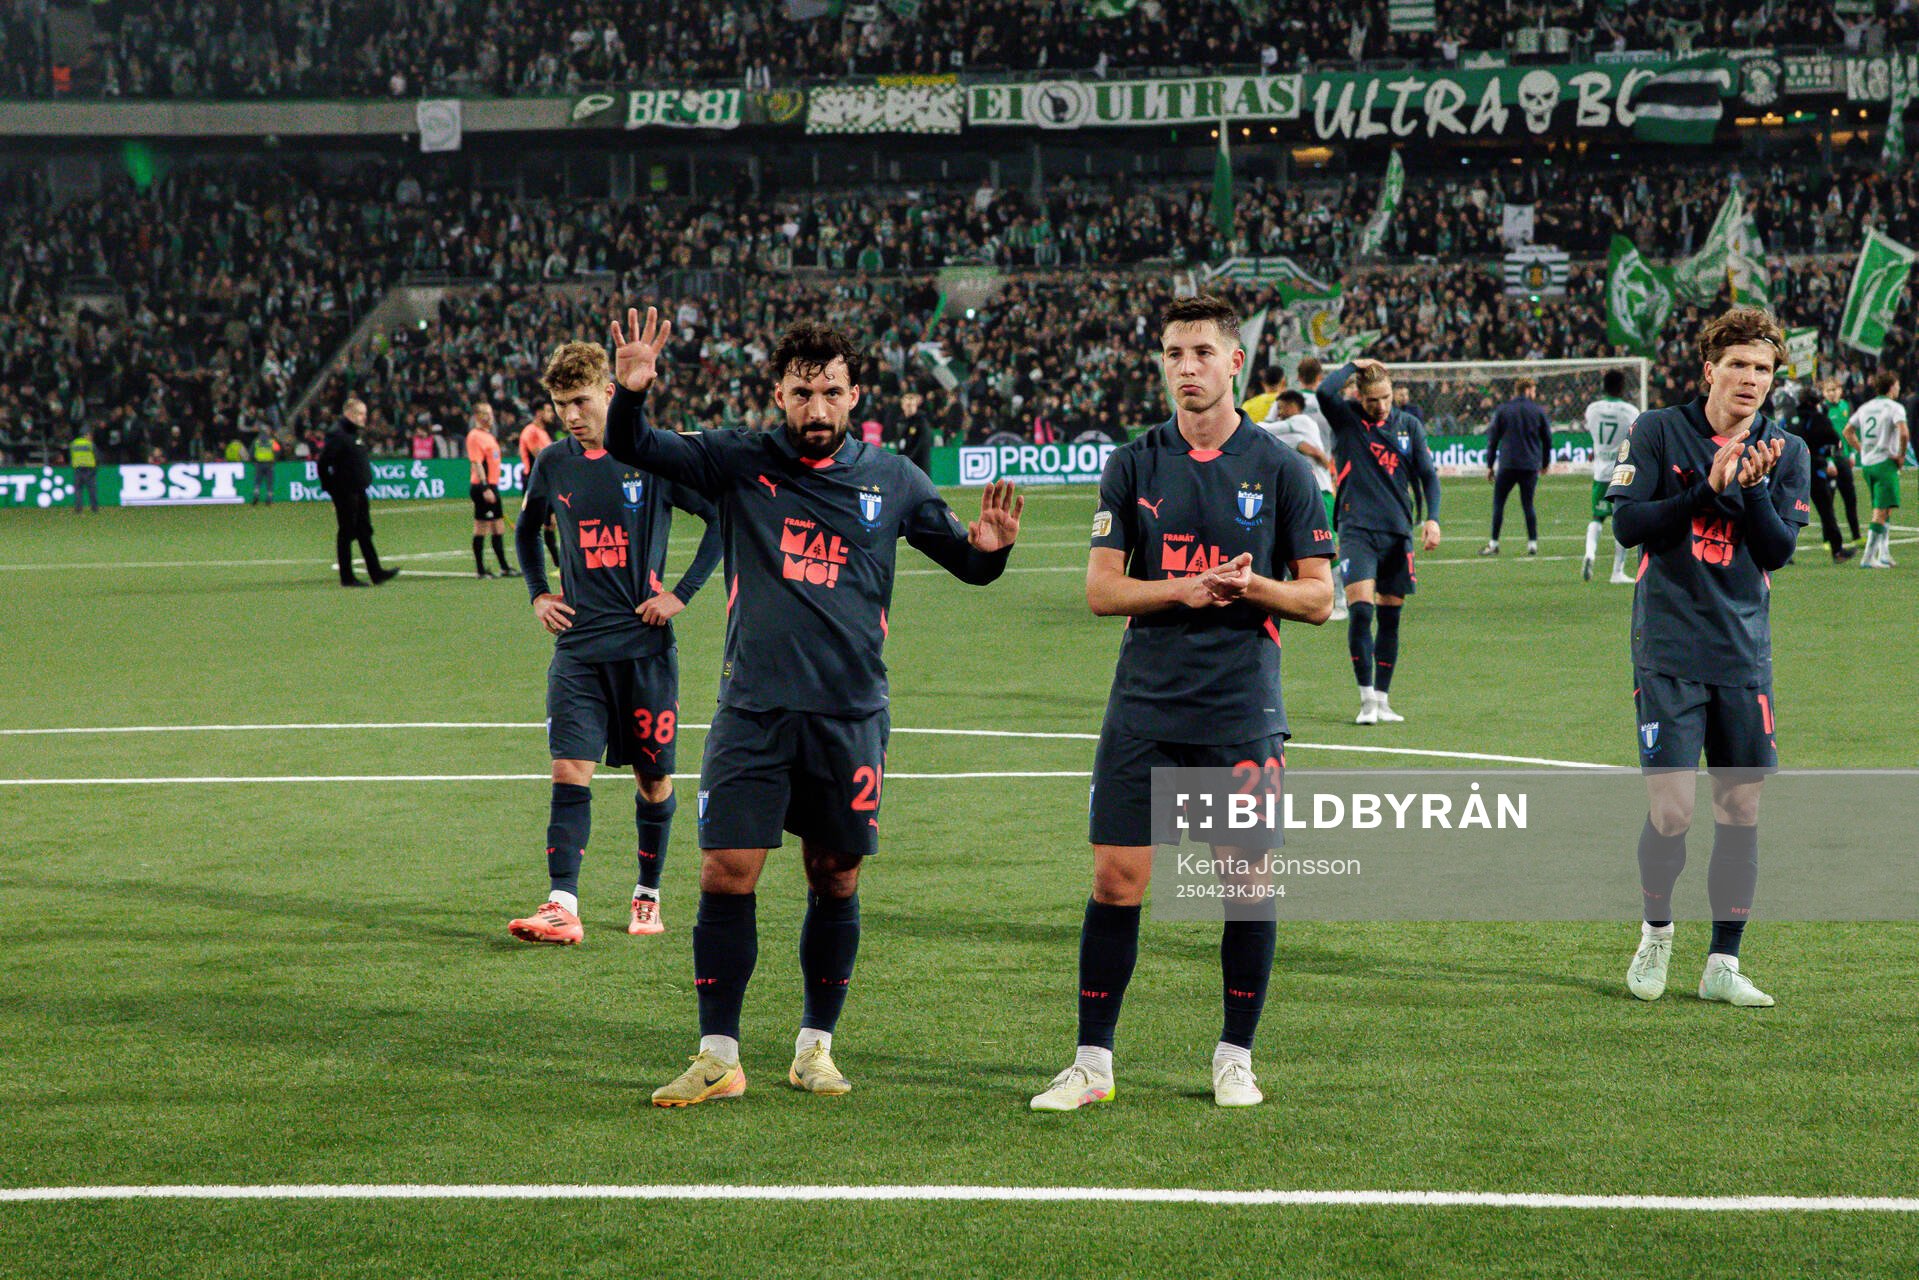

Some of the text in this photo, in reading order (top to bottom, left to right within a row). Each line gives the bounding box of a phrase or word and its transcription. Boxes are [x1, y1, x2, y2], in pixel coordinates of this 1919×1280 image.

[1095, 78, 1295, 120] ULTRAS
[1313, 76, 1509, 140] ULTRA
[1599, 421, 1618, 445] 17
[1865, 416, 1877, 438] 2
[119, 462, 244, 500] BST
[411, 459, 429, 479] &
[414, 479, 445, 499] AB
[633, 707, 676, 745] 38
[1231, 757, 1282, 806] 23
